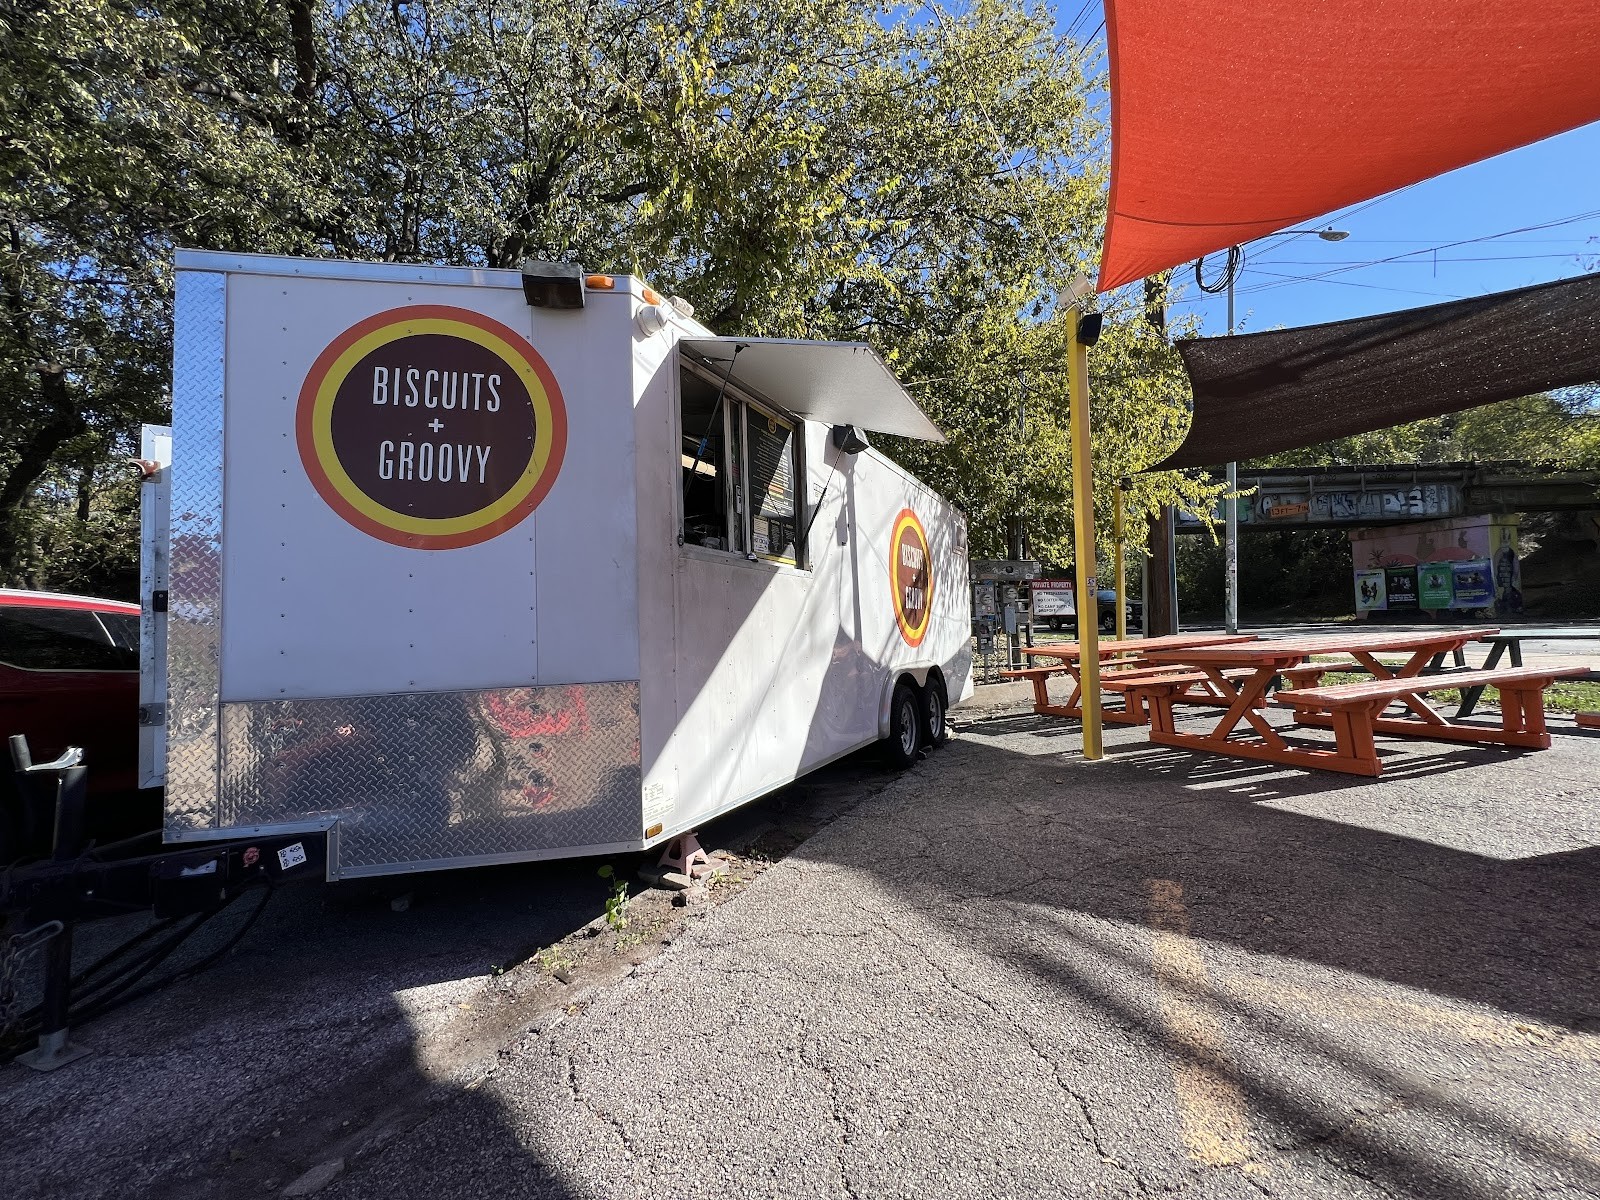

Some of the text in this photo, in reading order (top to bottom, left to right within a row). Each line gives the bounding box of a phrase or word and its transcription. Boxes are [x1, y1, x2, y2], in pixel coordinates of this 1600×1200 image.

[373, 366, 501, 412] BISCUITS
[428, 418, 444, 433] +
[378, 440, 491, 484] GROOVY
